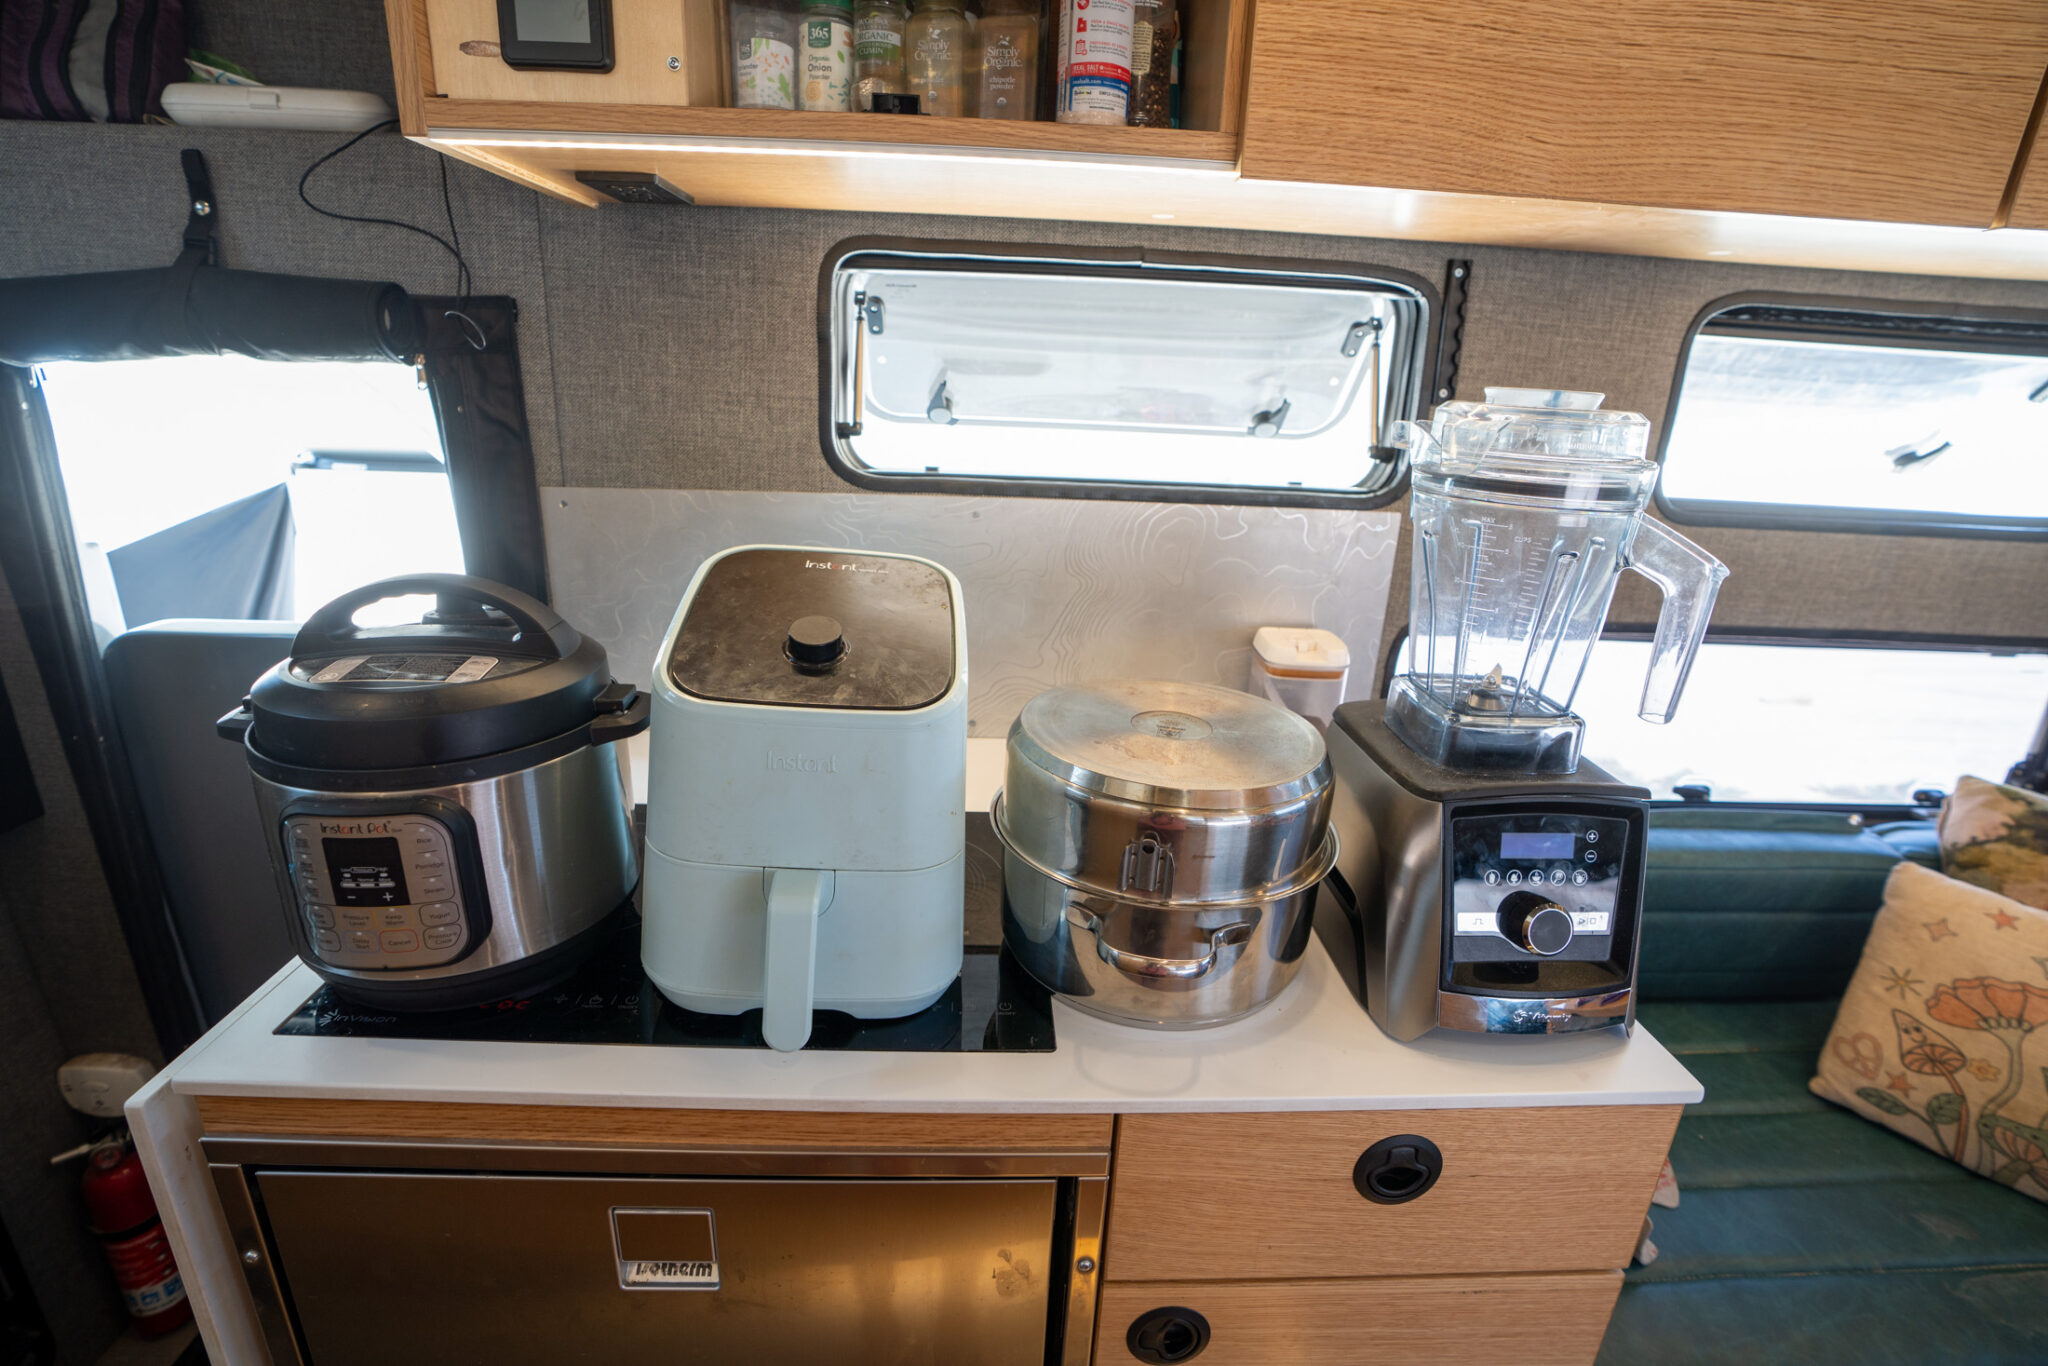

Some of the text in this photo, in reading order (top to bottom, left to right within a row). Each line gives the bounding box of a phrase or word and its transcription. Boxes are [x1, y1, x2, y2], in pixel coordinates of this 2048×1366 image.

[809, 26, 829, 40] 365
[987, 46, 1020, 58] Simply
[808, 63, 832, 73] Onion
[805, 560, 857, 571] Instant
[766, 750, 839, 775] Instant
[320, 823, 364, 834] Instant
[367, 822, 388, 834] Pot
